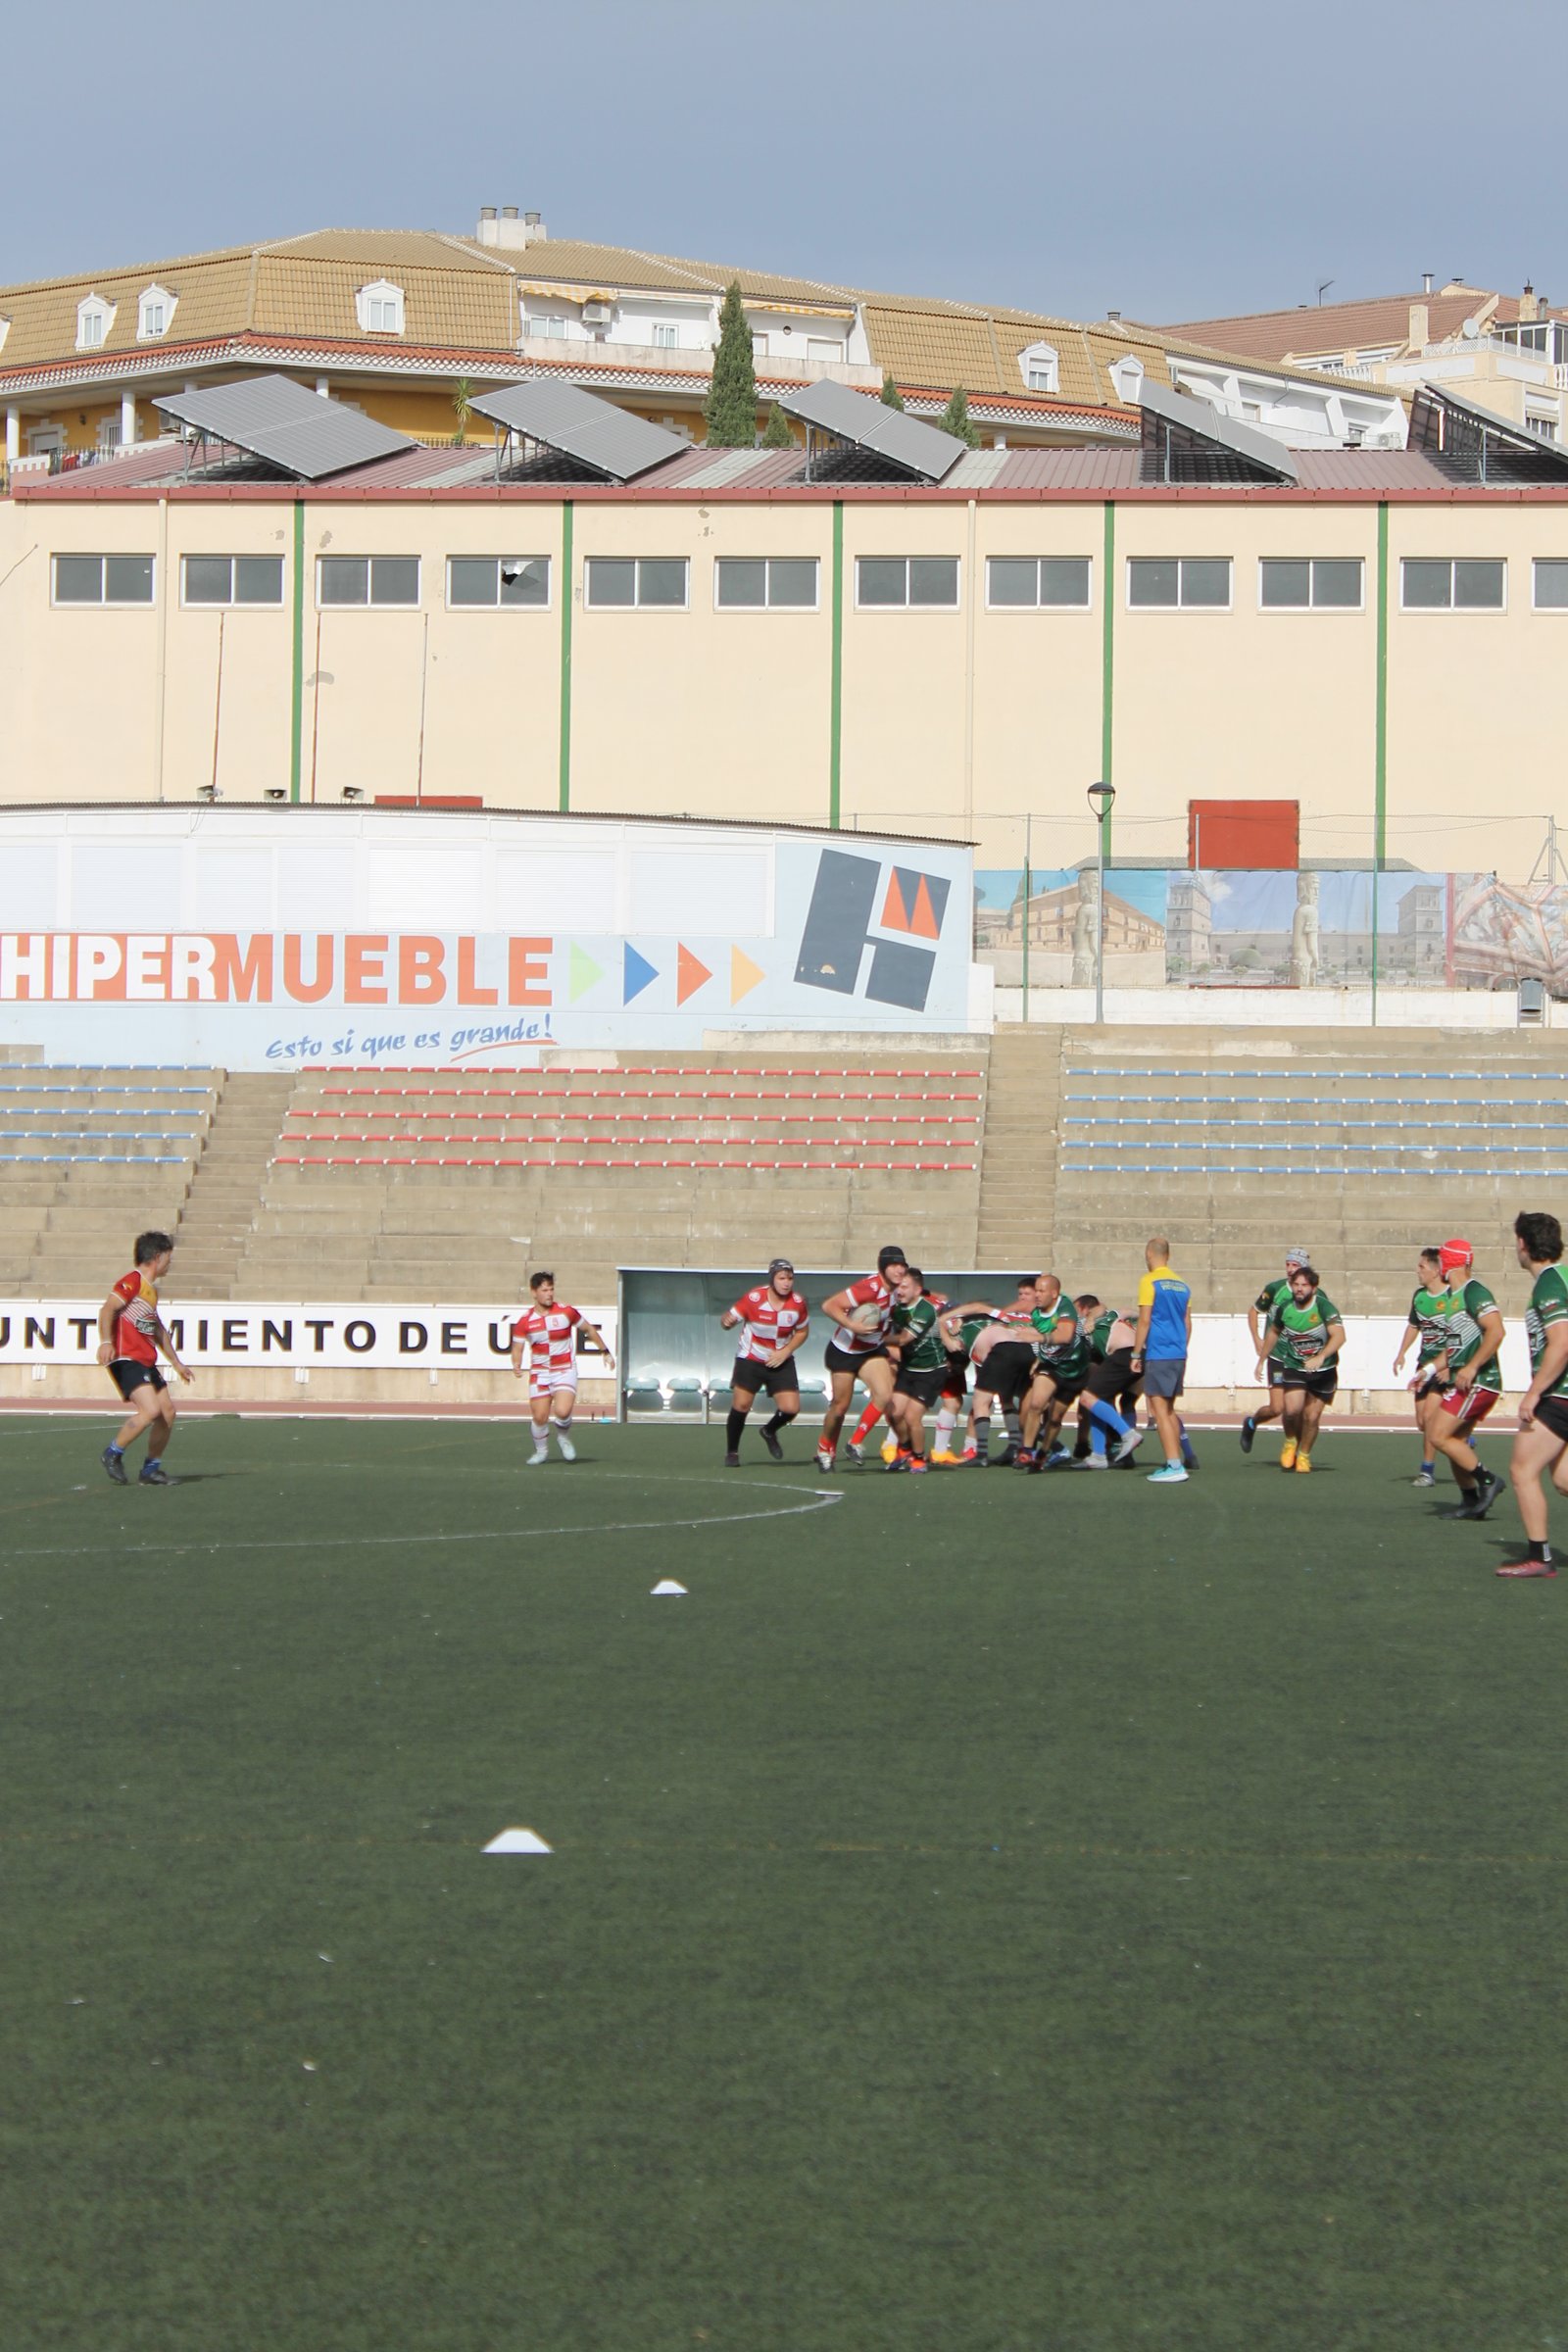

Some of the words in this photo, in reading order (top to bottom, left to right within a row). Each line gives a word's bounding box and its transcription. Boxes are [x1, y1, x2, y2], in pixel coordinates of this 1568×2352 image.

[0, 933, 554, 1006] HIPERMUEBLE
[265, 1035, 322, 1059] Esto
[360, 1034, 407, 1060] que
[414, 1030, 441, 1049] es
[449, 1012, 553, 1052] grande!
[399, 1321, 467, 1354] DE
